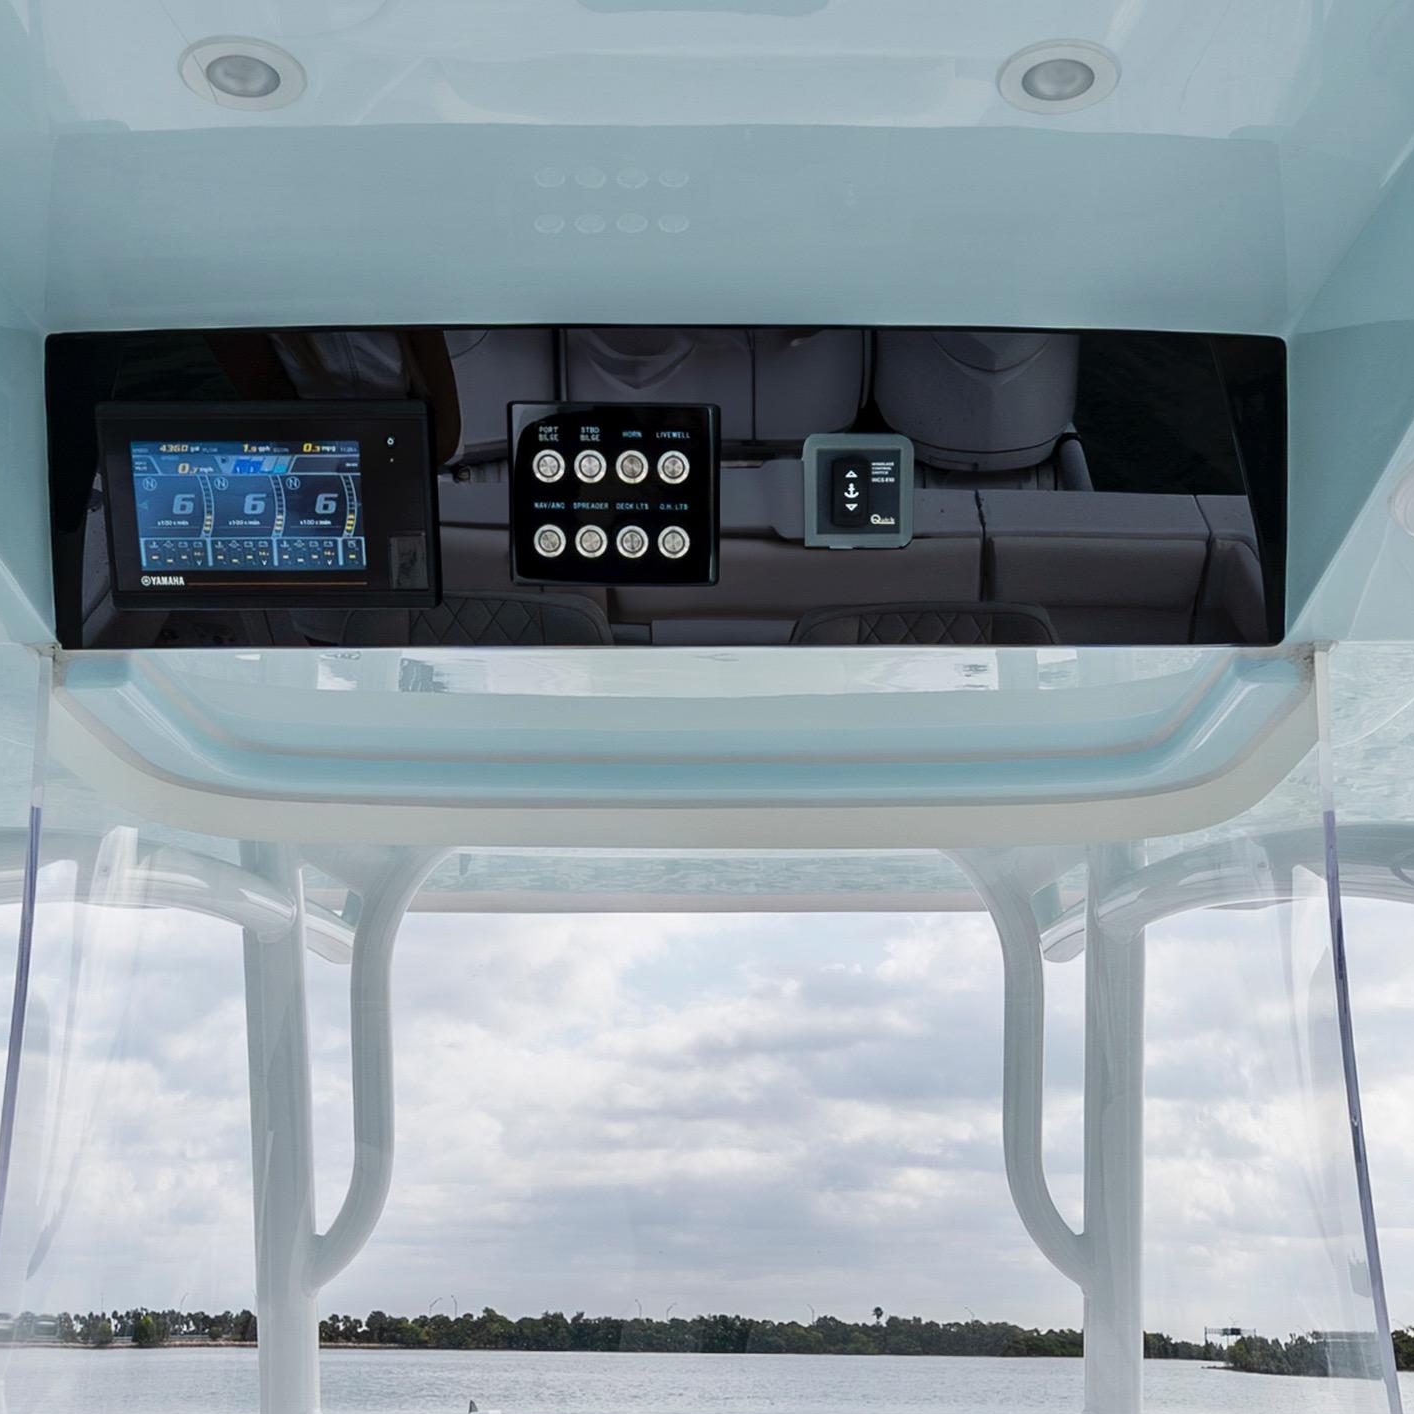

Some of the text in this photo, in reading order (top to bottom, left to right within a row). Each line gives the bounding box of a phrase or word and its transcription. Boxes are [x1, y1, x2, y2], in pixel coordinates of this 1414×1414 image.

[539, 426, 559, 434] PORT
[580, 426, 600, 434] STBD
[622, 430, 642, 438] HORN
[538, 434, 559, 442] BILGE
[580, 434, 600, 442] BILGE
[656, 431, 690, 439] LIVEWELL
[172, 493, 195, 514] 6
[243, 493, 267, 514] 6
[315, 493, 338, 514] 6
[615, 502, 633, 510] DECK
[150, 576, 185, 586] YAMAHA
